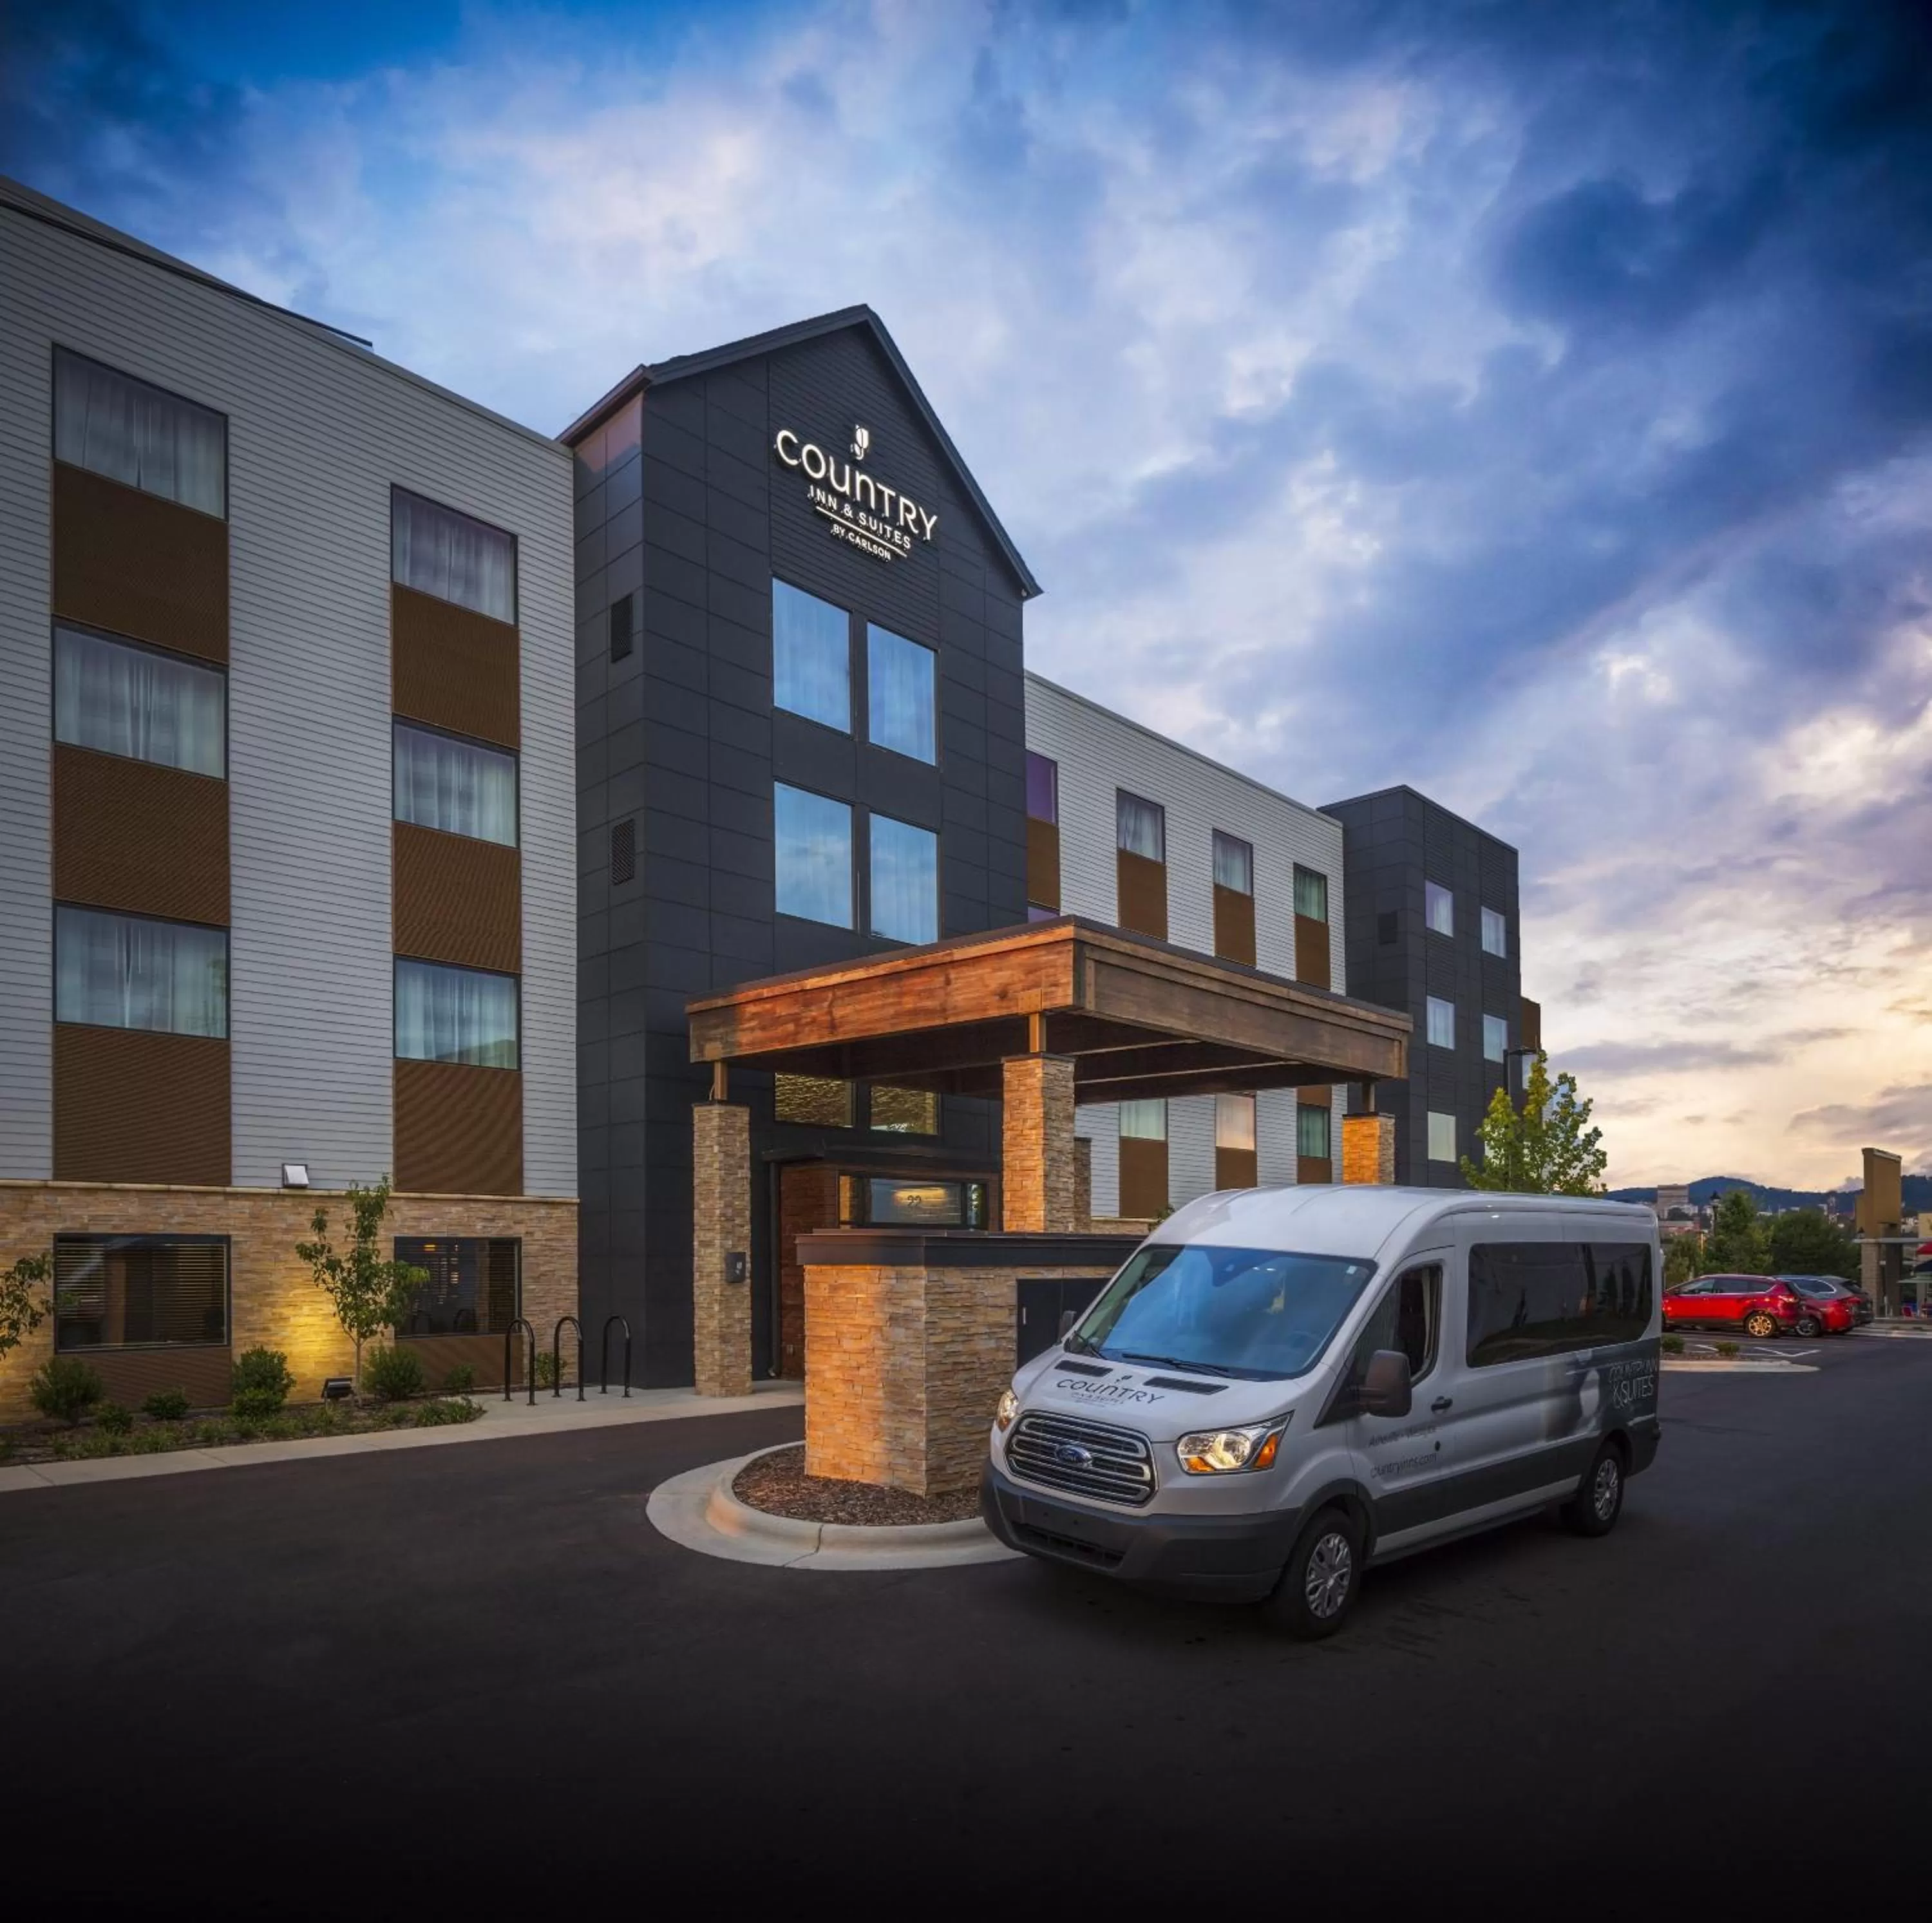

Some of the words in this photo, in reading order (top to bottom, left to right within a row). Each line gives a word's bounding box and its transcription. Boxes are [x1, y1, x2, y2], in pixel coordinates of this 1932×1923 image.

[776, 430, 938, 541] COUNTRY
[809, 485, 838, 511] INN
[843, 503, 853, 518] &
[858, 512, 911, 549] SUITES
[833, 524, 845, 538] BY
[848, 533, 891, 561] CARLSON
[1056, 1378, 1165, 1405] COUNTRY
